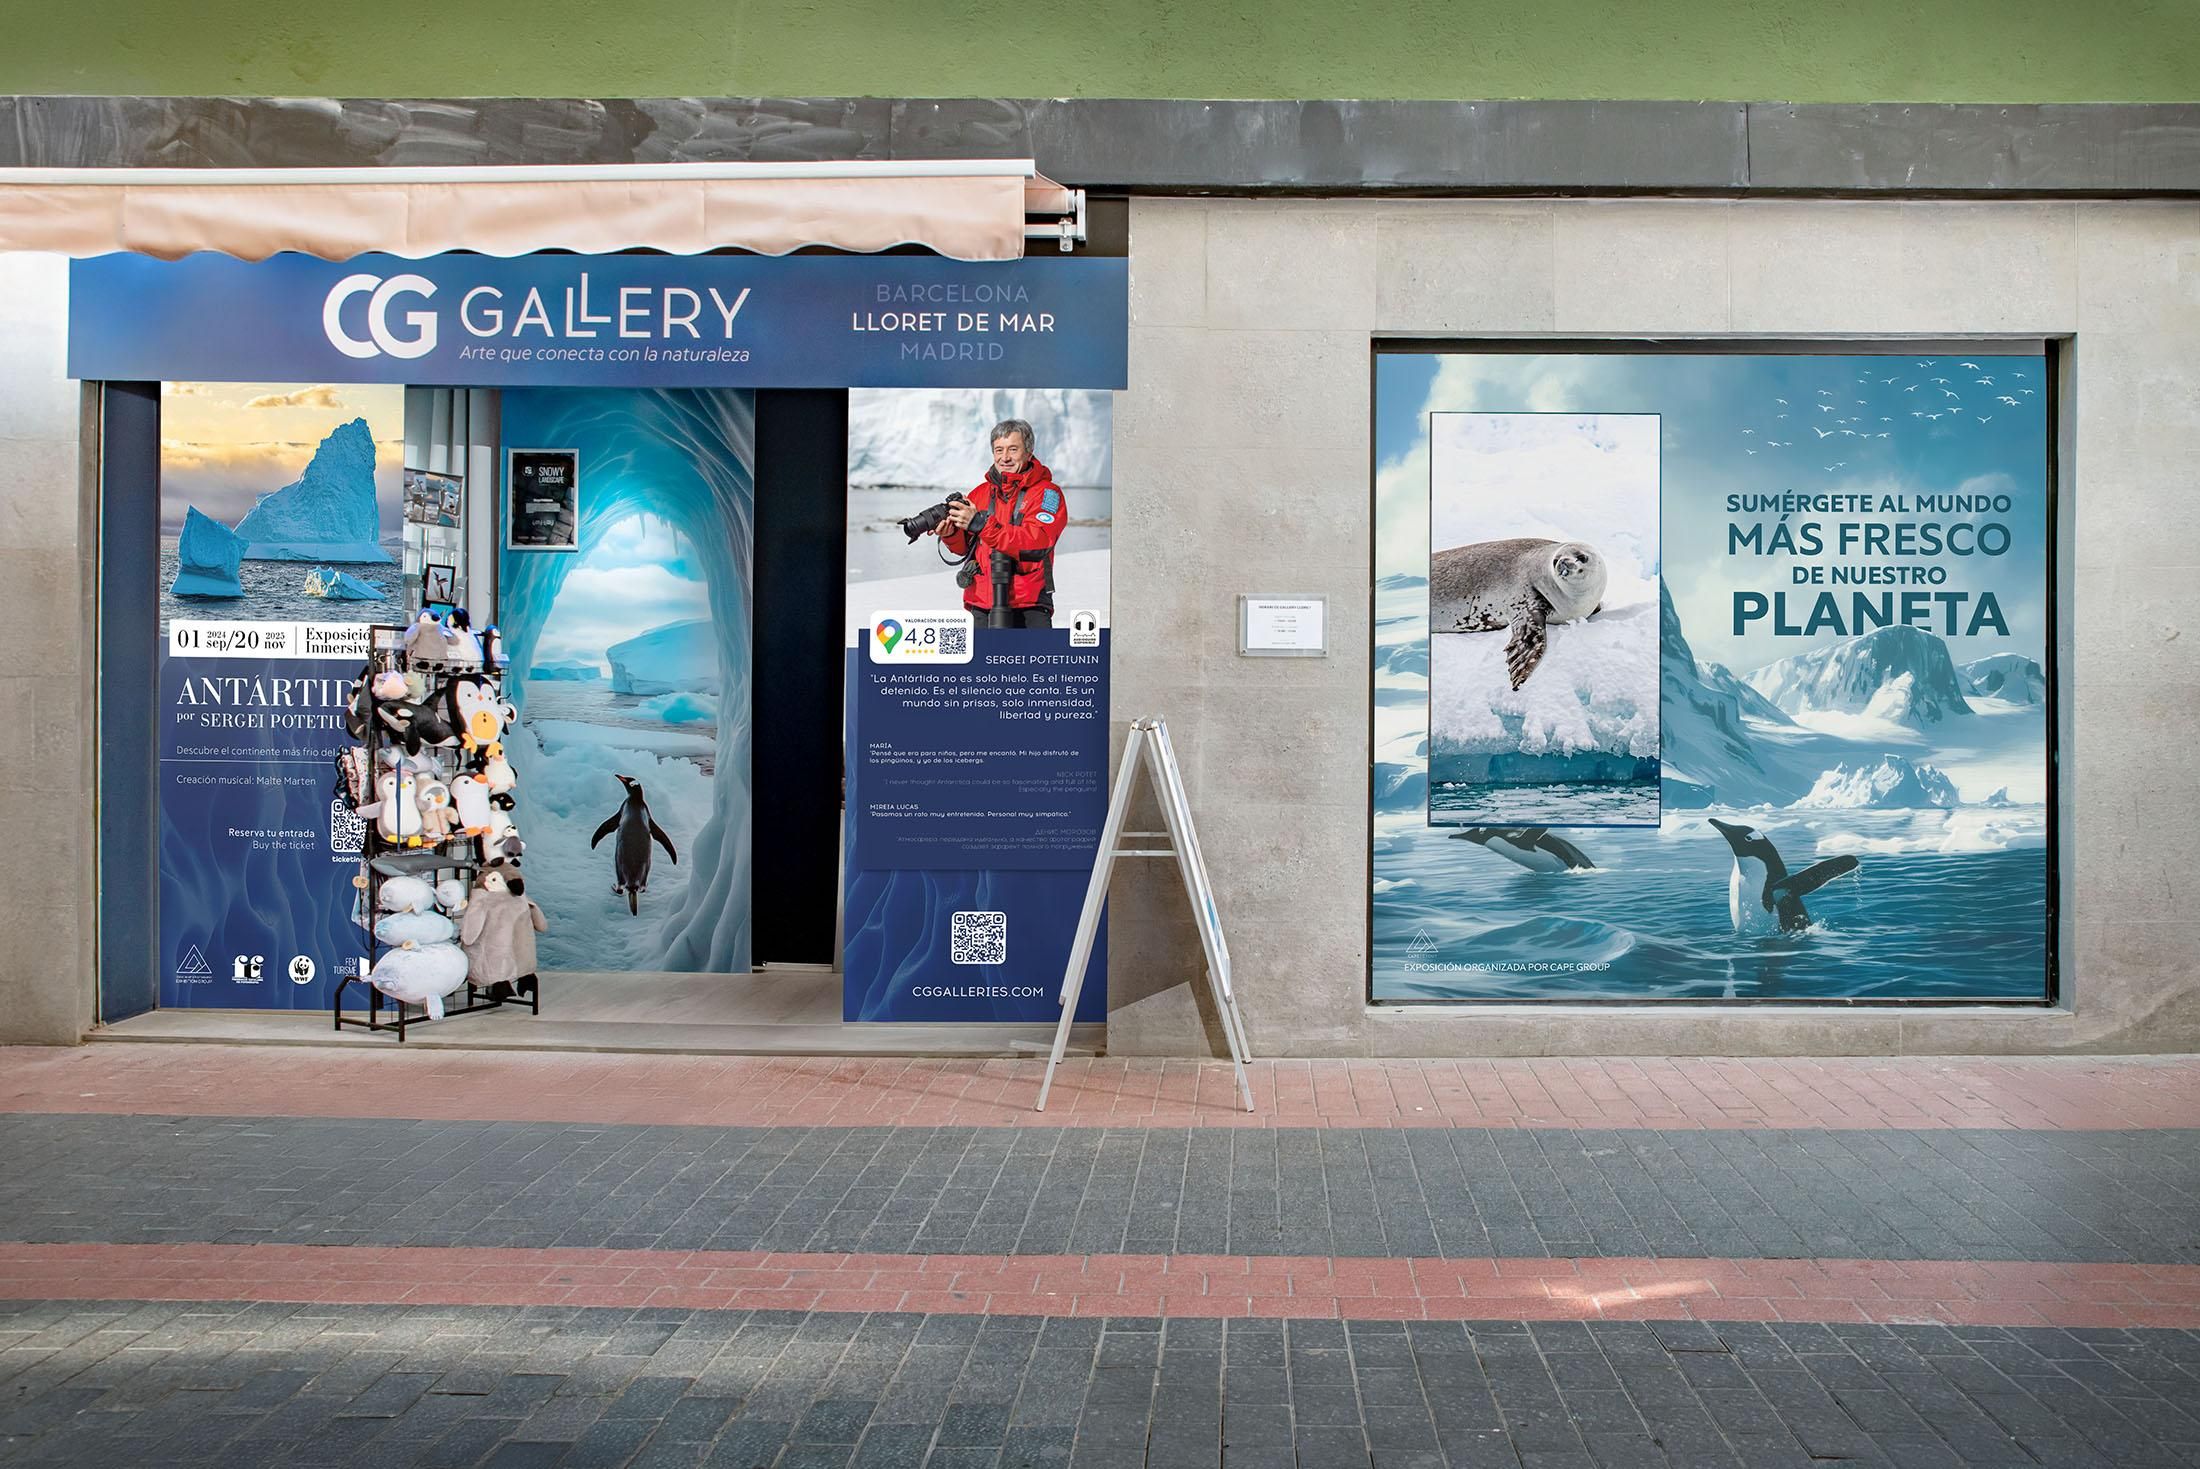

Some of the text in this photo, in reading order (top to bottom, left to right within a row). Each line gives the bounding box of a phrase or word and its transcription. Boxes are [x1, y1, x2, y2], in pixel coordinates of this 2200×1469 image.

[878, 284, 1028, 302] BARCELONA
[322, 272, 752, 359] CG GALLERY
[854, 313, 1054, 332] LLORET DE MAR
[459, 346, 749, 363] Arte que conecta con la naturaleza
[902, 343, 1003, 360] MADRID
[539, 467, 564, 476] SNOWY
[1726, 490, 2013, 514] SUMÉRGETE AL MUNDO
[1728, 514, 2012, 556] MÁS FRESCO
[1793, 566, 1946, 584] DE NUESTRO
[1732, 592, 2012, 636] PLANETA
[177, 629, 201, 648] 01
[306, 627, 370, 643] Exposició
[904, 628, 936, 646] 4,8
[206, 640, 227, 650] sep
[264, 641, 285, 649] nov
[986, 656, 1099, 665] SERGEI POTETIUNIN
[890, 674, 940, 683] Antártida
[976, 674, 998, 683] solo
[1002, 674, 1029, 683] hielo.
[1033, 674, 1045, 683] Es
[1048, 674, 1058, 683] el
[1062, 674, 1098, 684] tiempo
[177, 675, 355, 707] ANTÁRTID
[881, 687, 930, 696] detenido.
[934, 686, 946, 695] Es
[949, 686, 957, 695] el
[962, 686, 1002, 695] silencio
[1006, 688, 1026, 697] que
[1029, 687, 1062, 695] canta.
[1066, 686, 1078, 695] Es
[903, 699, 1095, 709] mundo sin prisas, solo inmensidad,
[177, 712, 346, 729] por SERGEI POTETIU
[1000, 711, 1041, 720] libertad
[1045, 713, 1052, 722] y
[177, 746, 219, 755] Descubre
[221, 747, 229, 755] el
[231, 747, 280, 756] continente
[283, 747, 300, 756] más
[321, 748, 335, 757] del
[177, 775, 317, 786] Creación musical: Malte Marten
[229, 828, 315, 839] Reserva tu entrada
[253, 840, 315, 850] Buy the ticket
[345, 957, 357, 966] FEM
[1404, 962, 1610, 972] EXPOSICIÓN ORGANIZADA POR CAPE GROUP
[913, 987, 1043, 997] CGGALLERIES.COM
